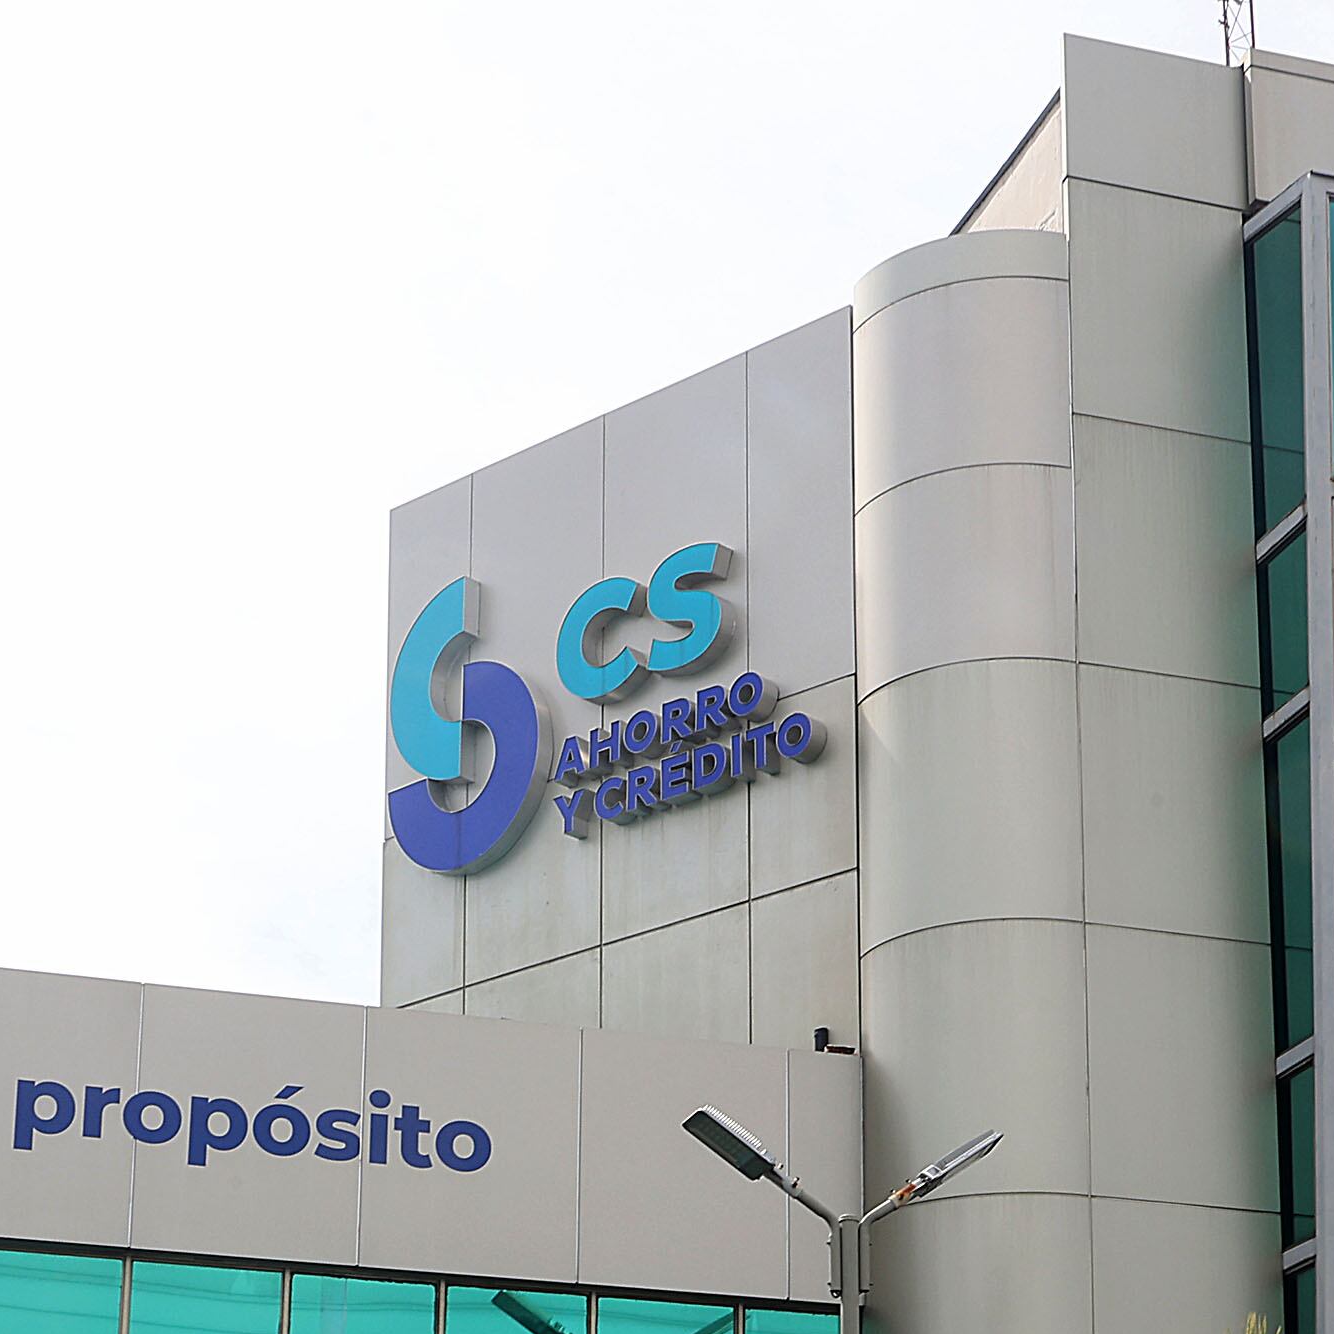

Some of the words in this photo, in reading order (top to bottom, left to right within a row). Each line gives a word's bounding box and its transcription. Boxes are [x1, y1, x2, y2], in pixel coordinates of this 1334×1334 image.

[556, 541, 725, 701] CS
[553, 671, 766, 783] AHORRO
[12, 1074, 493, 1174] propósito
